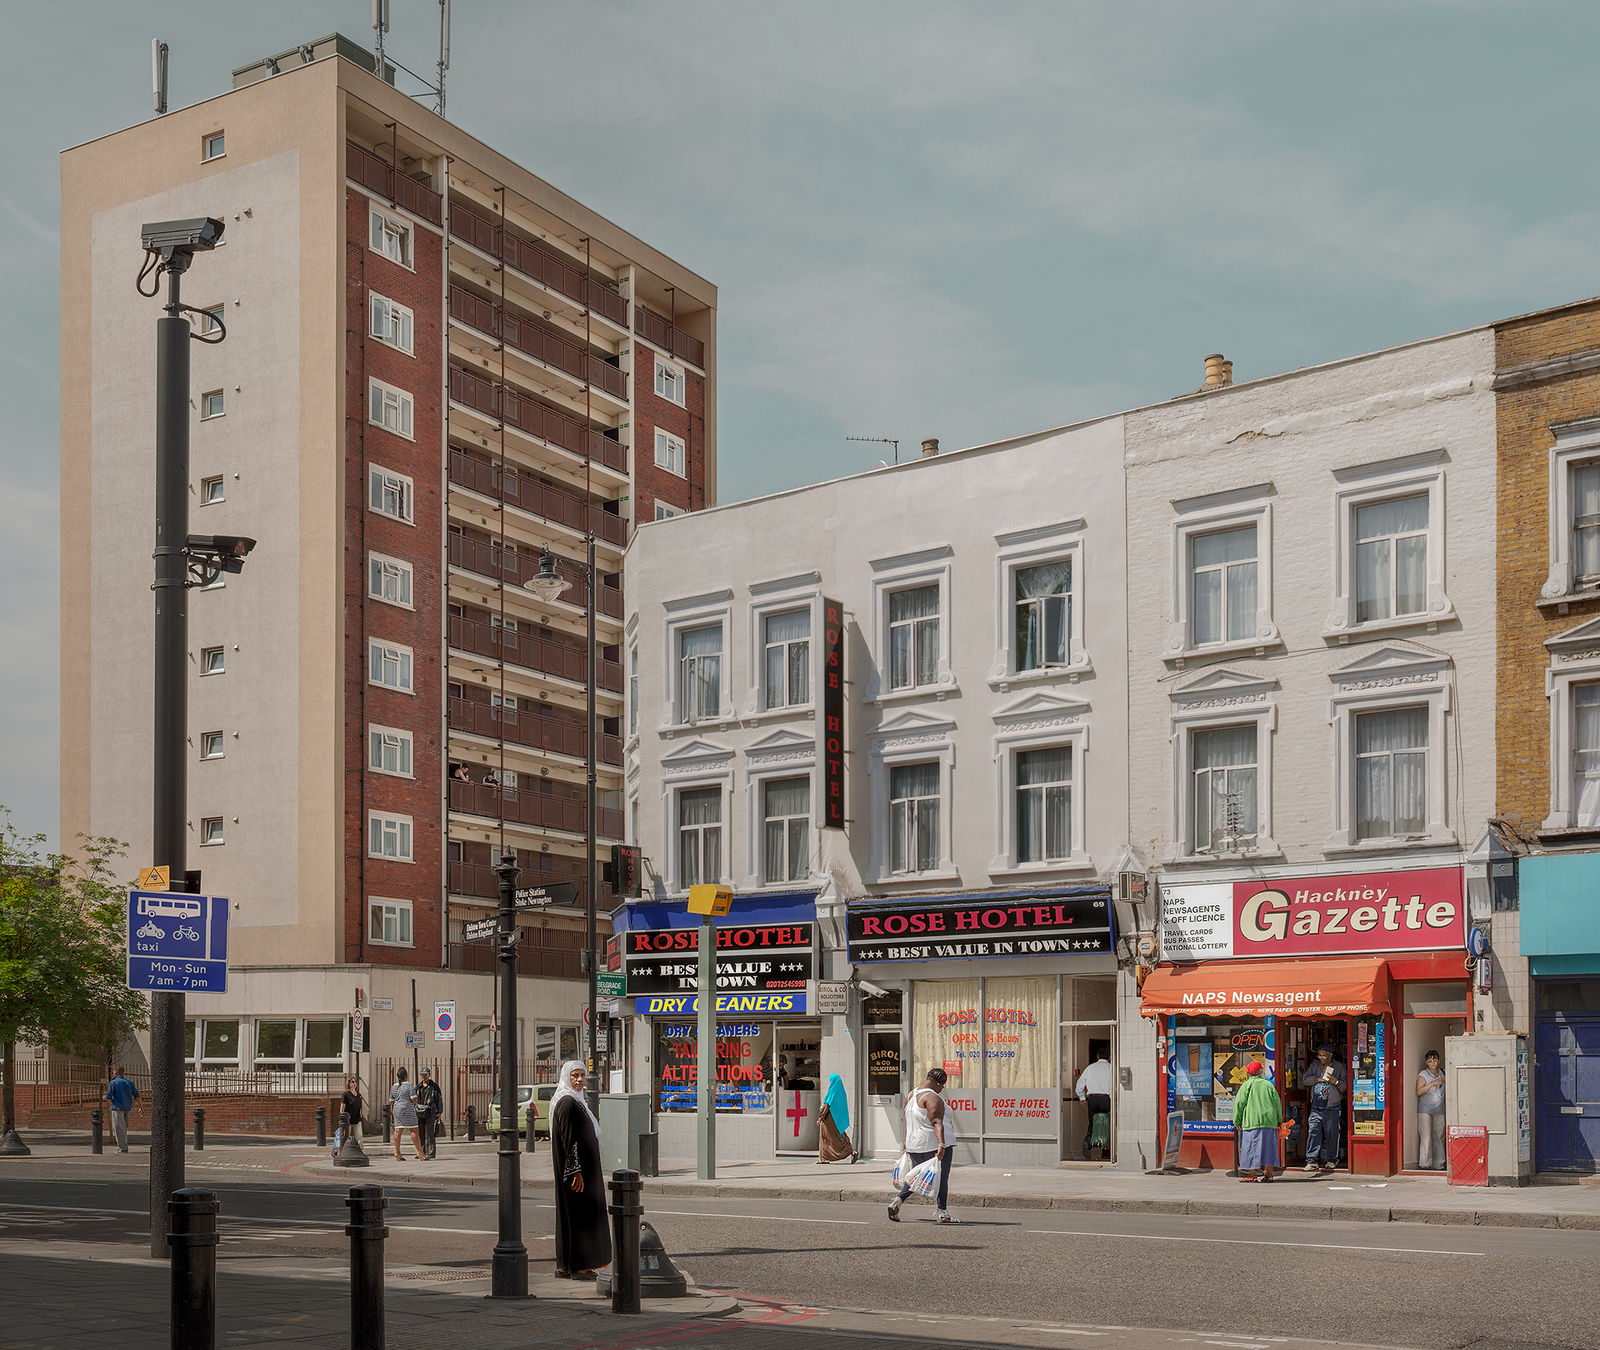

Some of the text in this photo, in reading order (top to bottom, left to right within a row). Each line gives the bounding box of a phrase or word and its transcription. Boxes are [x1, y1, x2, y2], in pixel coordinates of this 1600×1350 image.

[827, 607, 840, 819] ROSE HOTEL
[621, 848, 640, 858] ROSE
[515, 888, 546, 899] Police Station
[1294, 888, 1388, 904] Hackney
[515, 896, 552, 906] Stoke Newington
[1163, 898, 1185, 906] NAPS
[1163, 905, 1221, 915] NEWSAGENTS
[1239, 889, 1456, 942] Gazette
[862, 906, 1073, 935] ROSE HOTEL
[1189, 914, 1226, 922] LICENCE
[634, 927, 809, 951] ROSE HOTEL
[137, 942, 158, 952] taxi
[888, 939, 1070, 958] BEST VALUE IN TOWN
[151, 962, 176, 972] Mon
[185, 964, 206, 974] Sun
[660, 964, 698, 976] BES
[597, 982, 622, 990] BELGRADE
[716, 976, 757, 988] OWN
[1182, 990, 1322, 1006] NAPS Newsagent
[649, 998, 687, 1012] DRY
[938, 1008, 1036, 1028] ROSE HOTEL
[666, 1026, 692, 1038] DRY
[952, 1032, 1019, 1044] OPEN 24 Hours
[1232, 1034, 1265, 1046] OPEN
[870, 1050, 900, 1060] BIROL
[992, 1099, 1050, 1108] ROSE HOTEL
[1026, 1110, 1050, 1118] HOURS
[1450, 1126, 1484, 1135] Gazette
